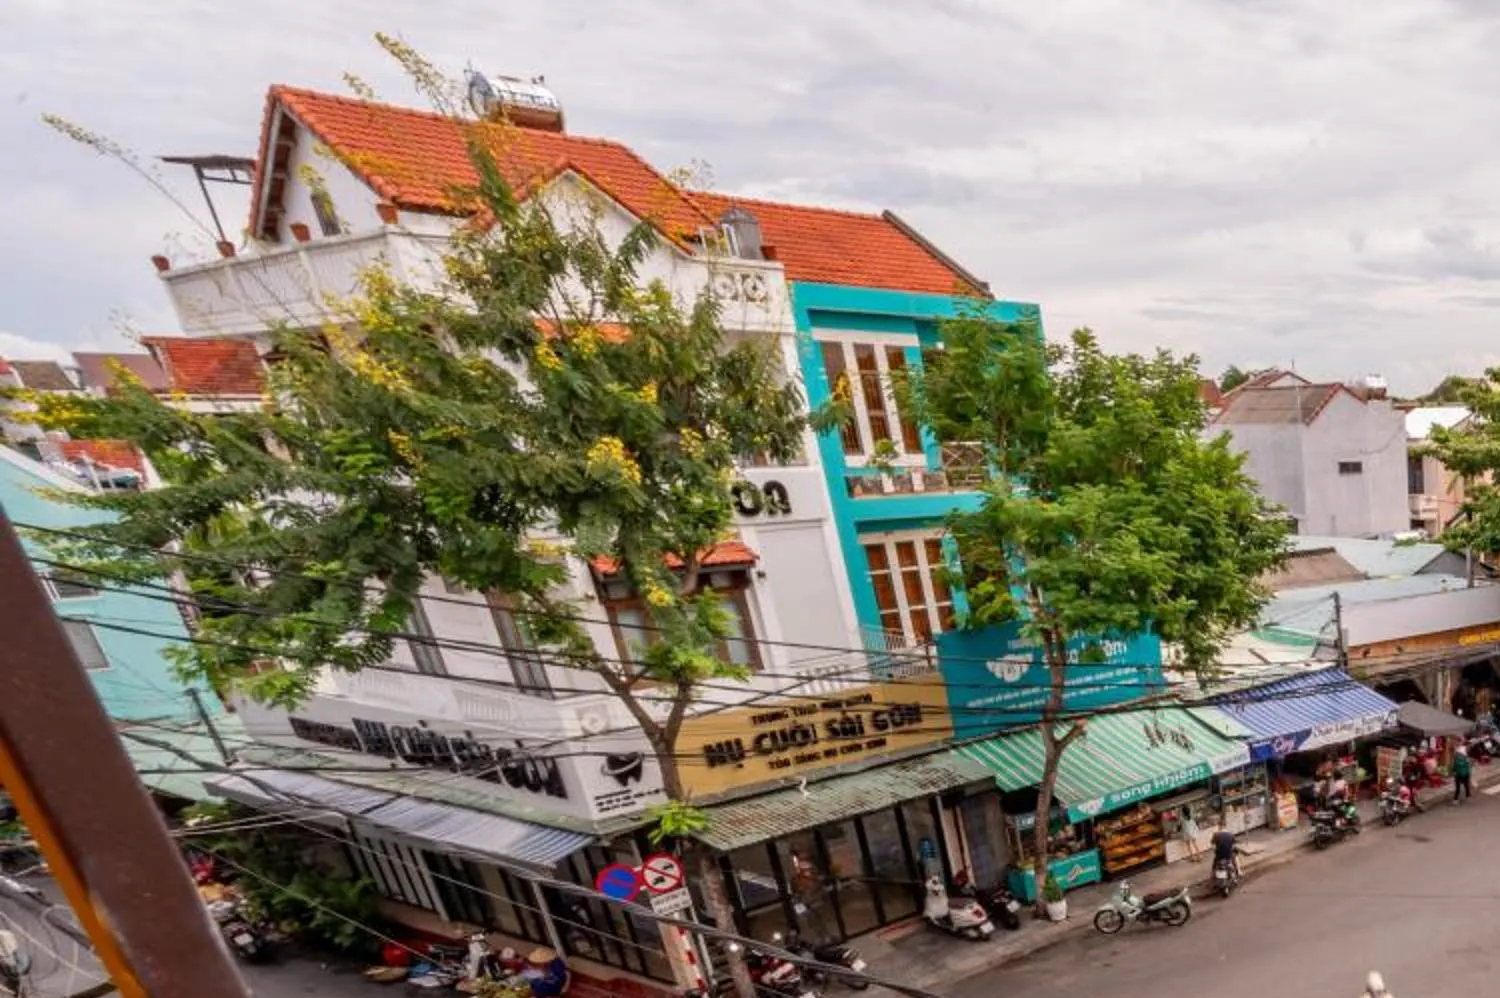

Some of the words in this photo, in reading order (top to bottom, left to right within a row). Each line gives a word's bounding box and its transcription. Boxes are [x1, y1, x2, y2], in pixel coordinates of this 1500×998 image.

[703, 737, 745, 768] NỤ
[753, 720, 818, 755] CƯỜI
[825, 711, 865, 739] SÀI
